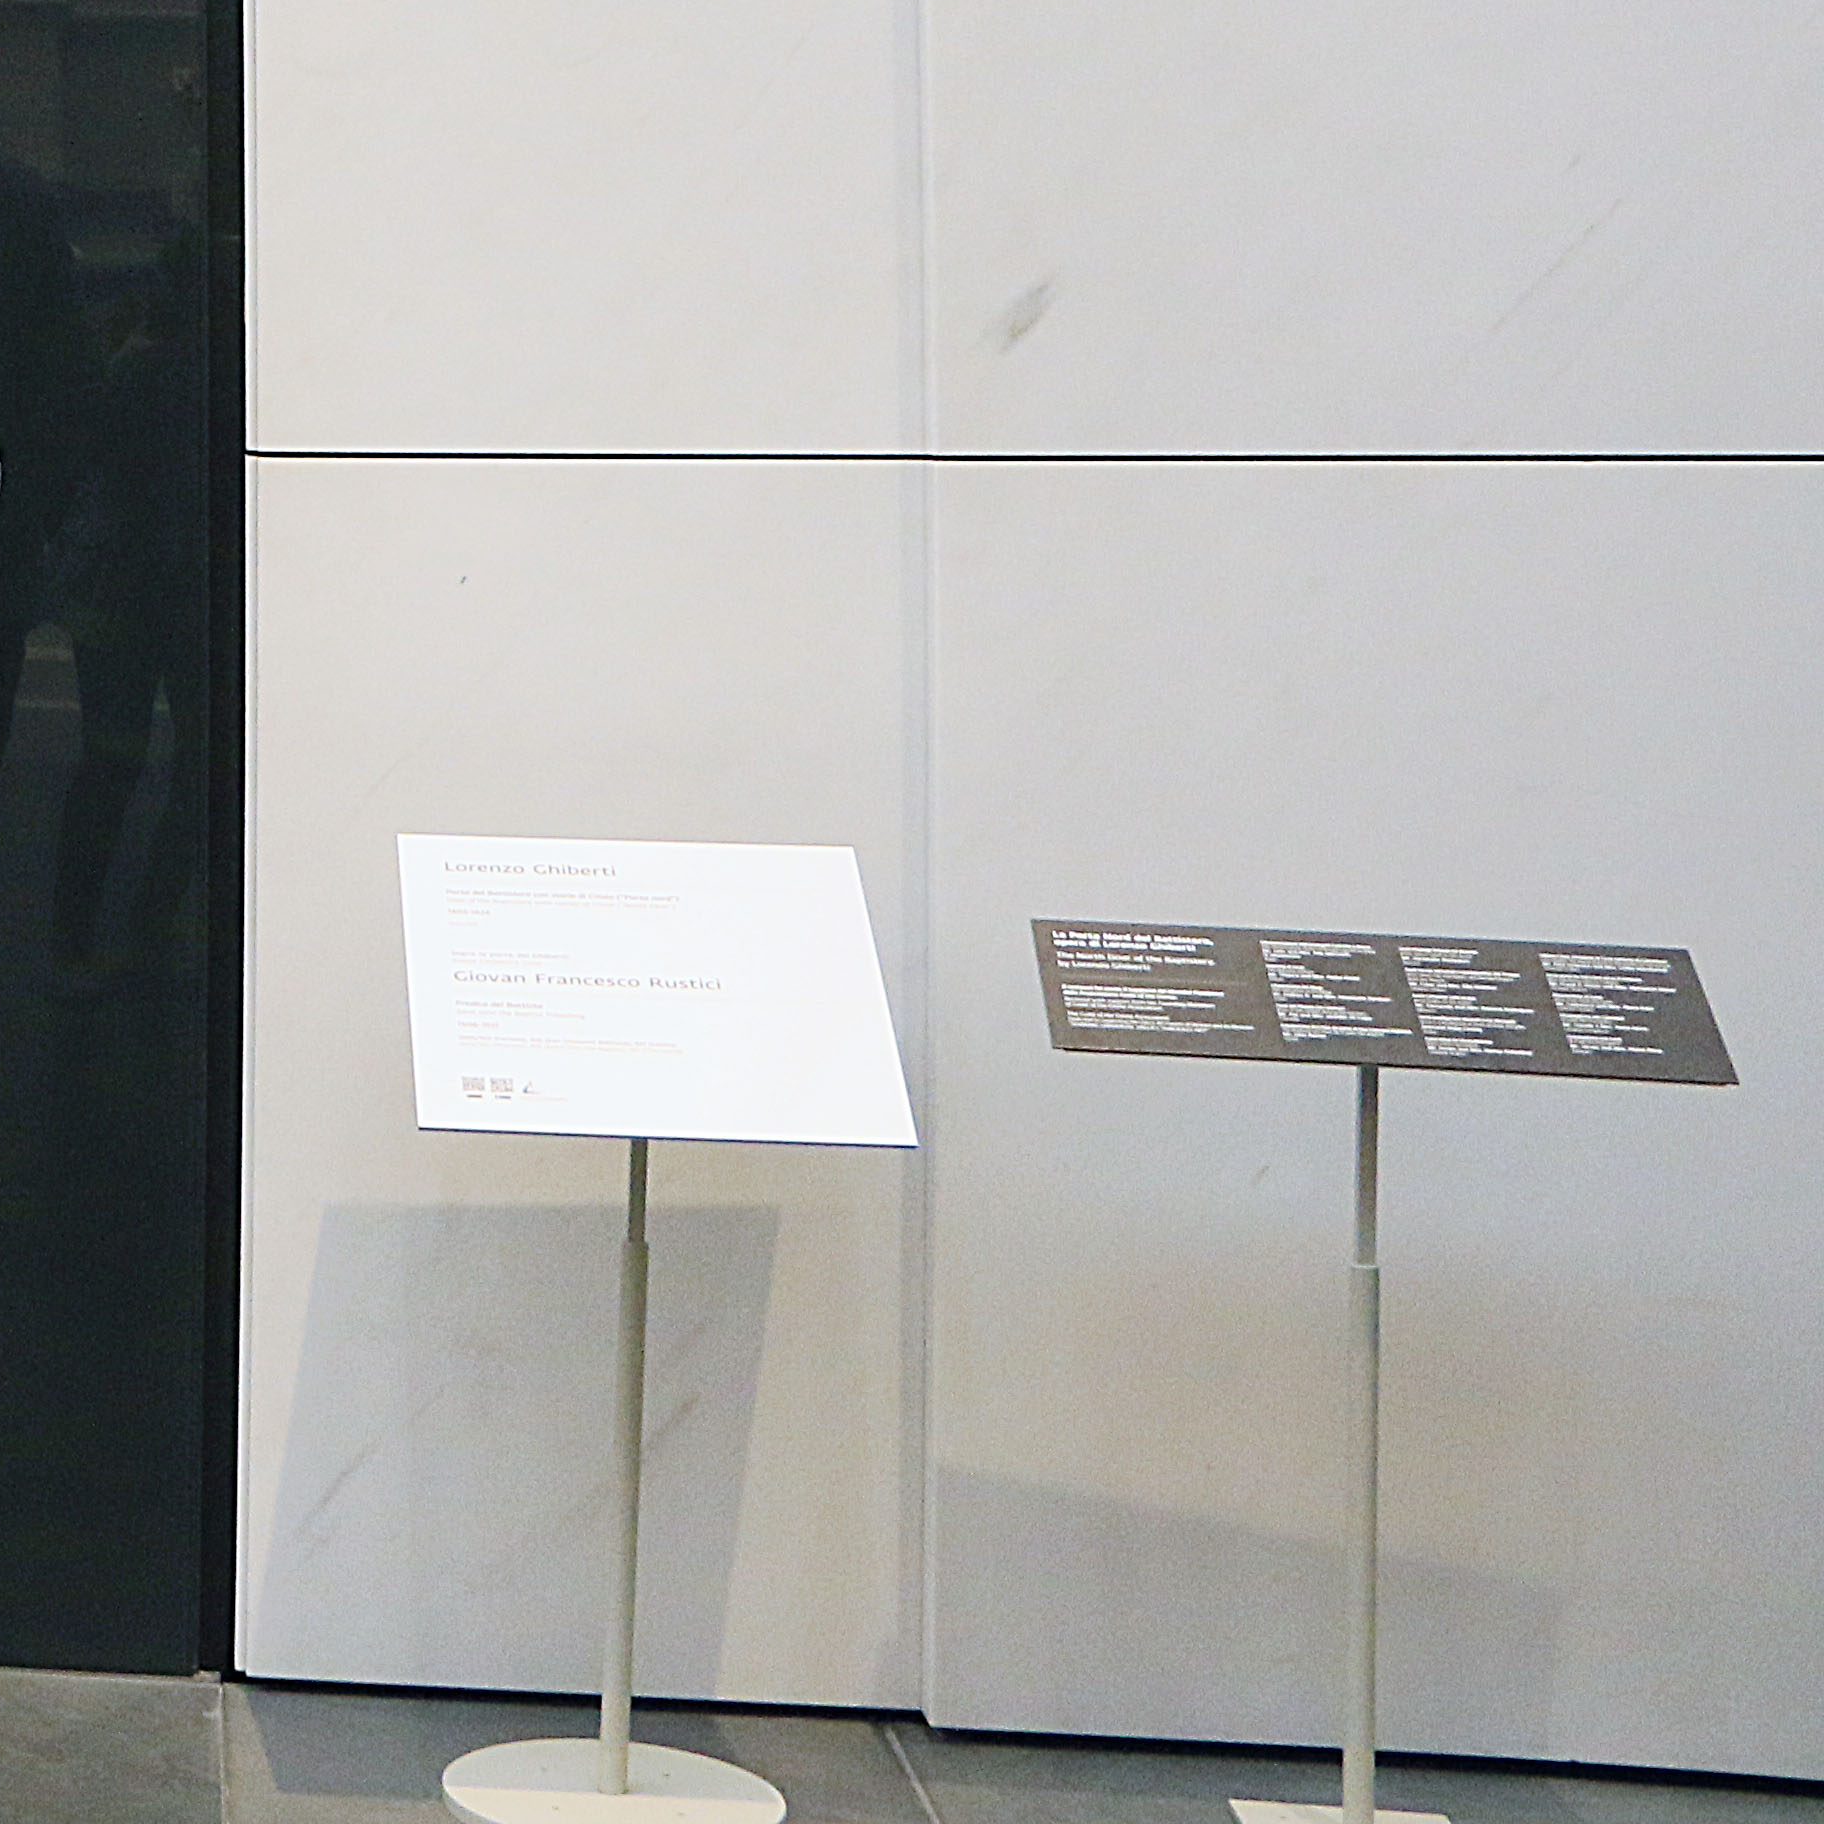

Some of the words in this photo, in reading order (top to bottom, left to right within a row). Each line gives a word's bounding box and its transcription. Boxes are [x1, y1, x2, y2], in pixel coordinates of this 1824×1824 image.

[444, 861, 526, 874] Lorenzo
[533, 863, 617, 877] Ghiberti
[452, 969, 527, 984] Giovan
[535, 972, 641, 988] Francesco
[649, 976, 722, 991] Rustici
